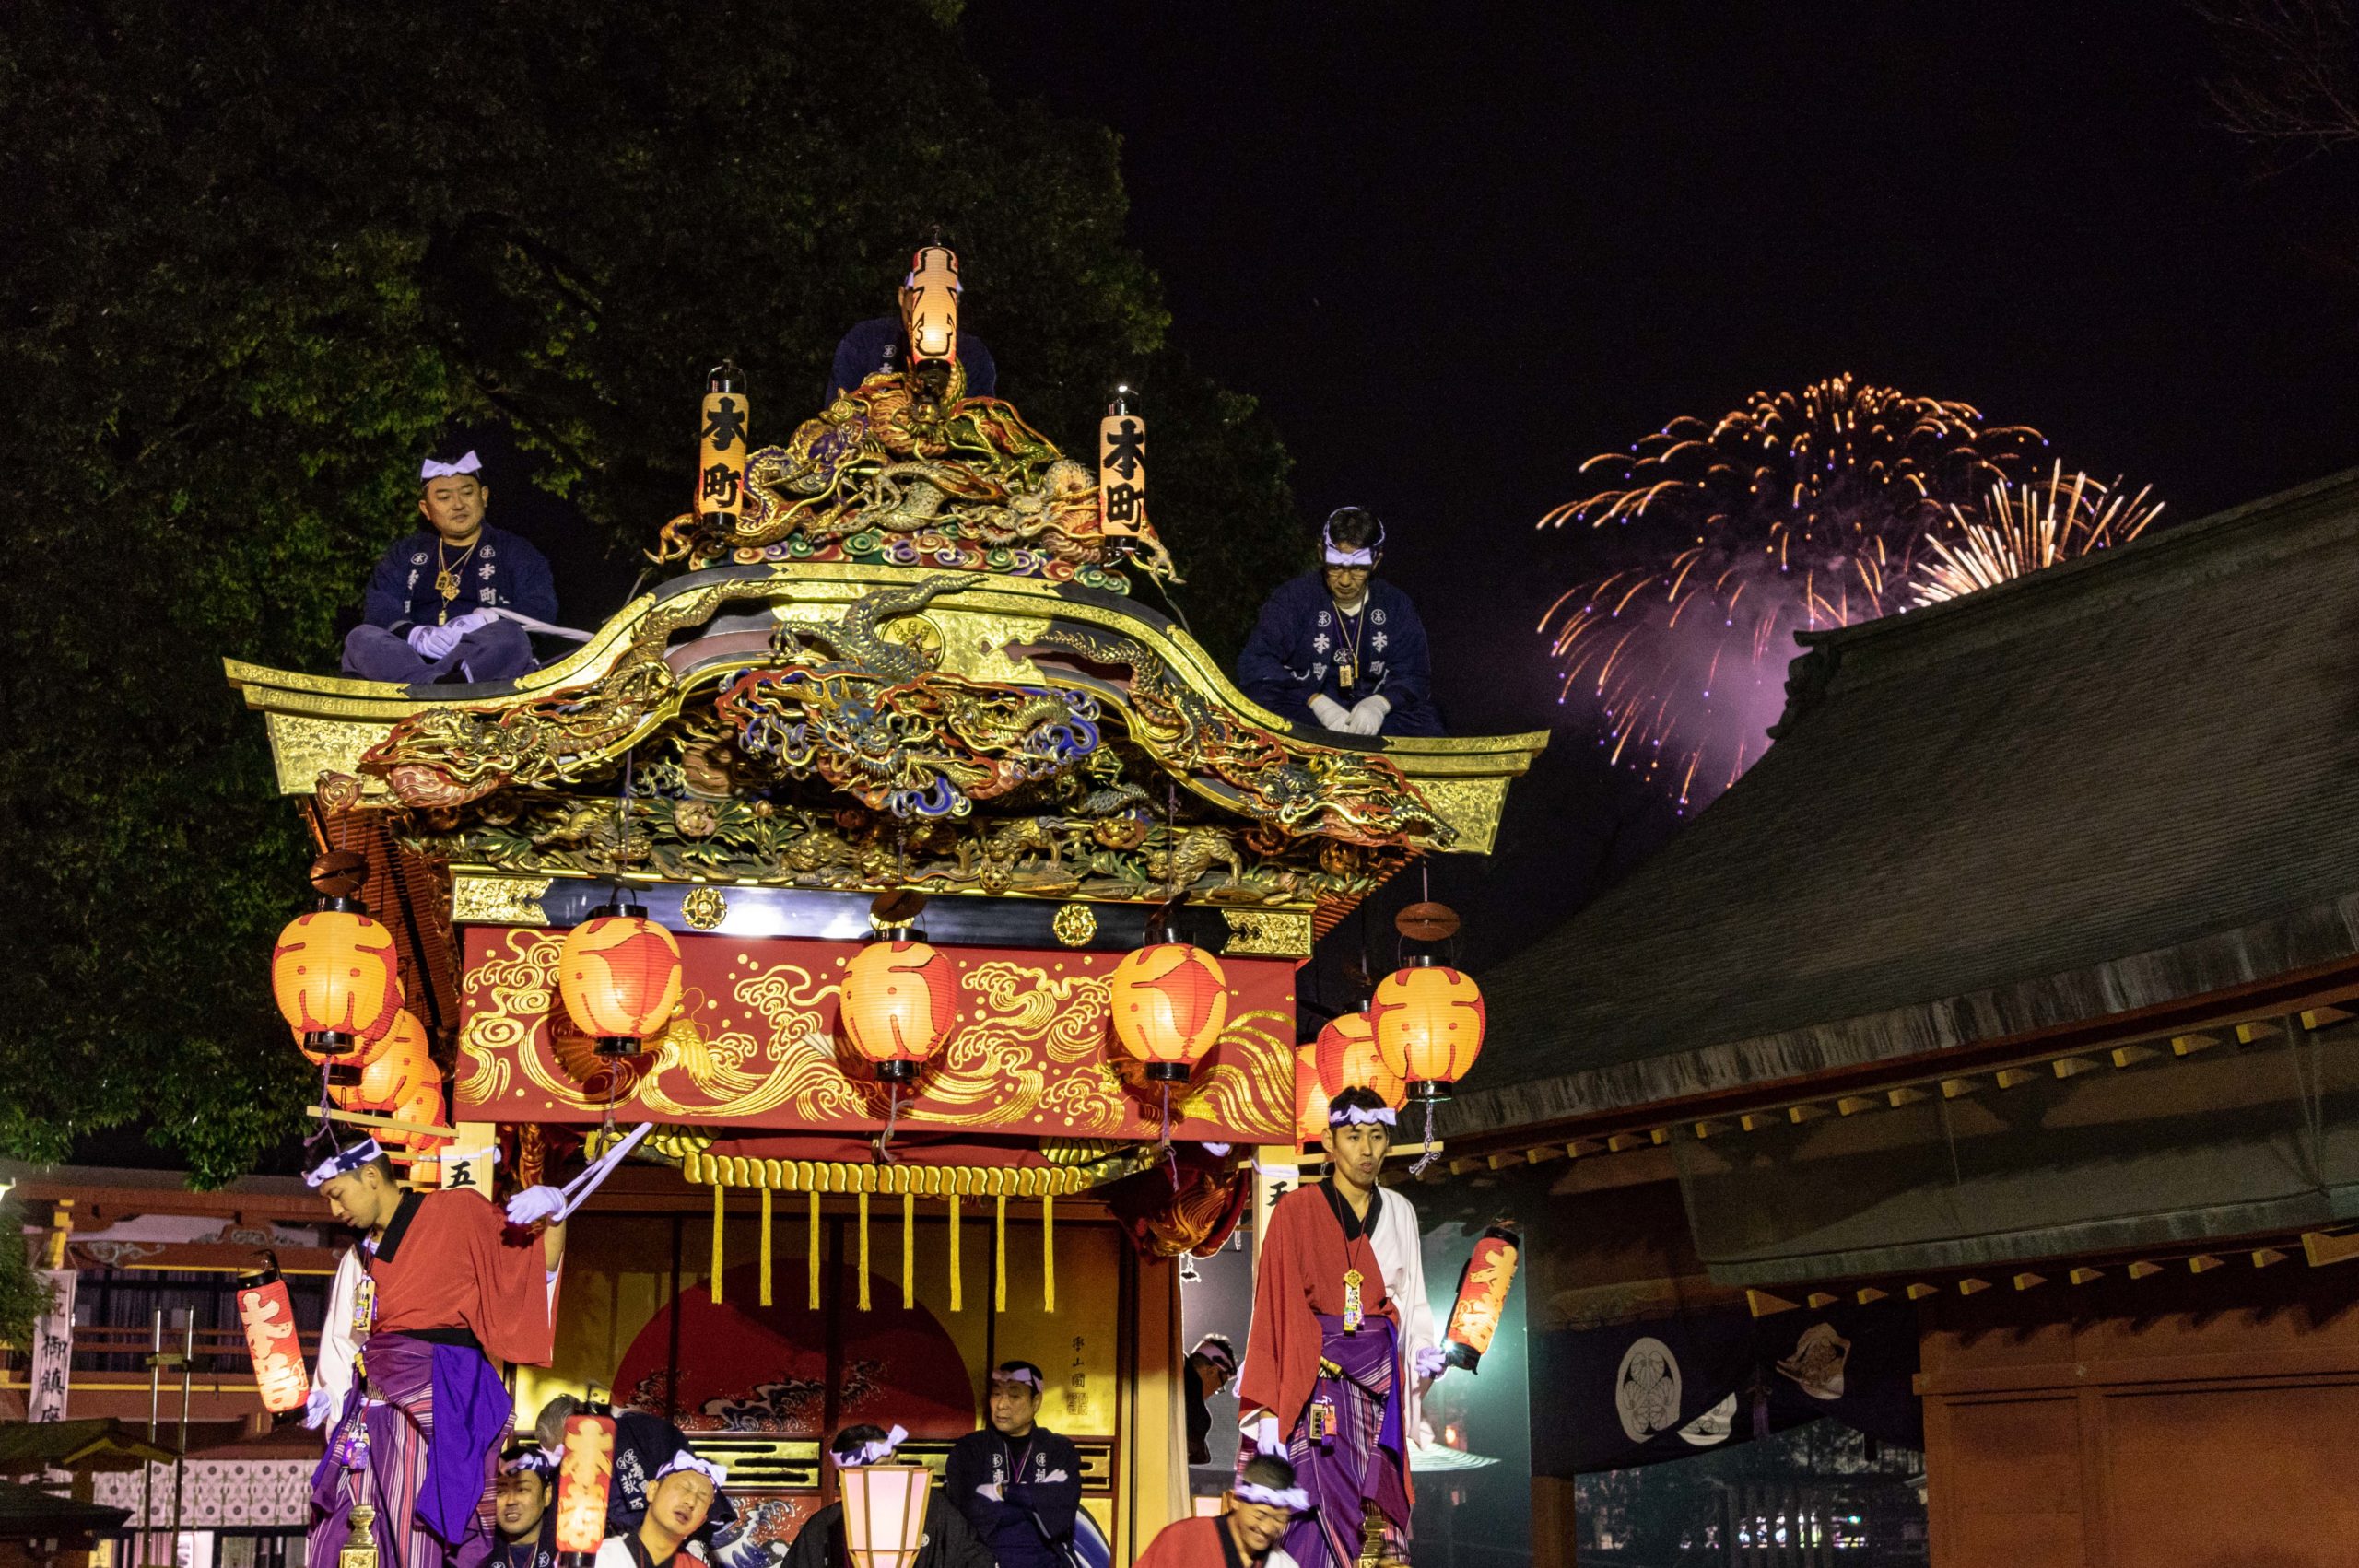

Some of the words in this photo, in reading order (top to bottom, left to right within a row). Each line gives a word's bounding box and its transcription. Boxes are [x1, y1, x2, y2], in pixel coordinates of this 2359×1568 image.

[701, 396, 745, 508] 本町
[1102, 418, 1144, 533] 本町
[478, 563, 497, 605] 本町
[1313, 632, 1331, 681] 本町
[1370, 631, 1388, 675] 本町
[445, 1161, 477, 1188] 五
